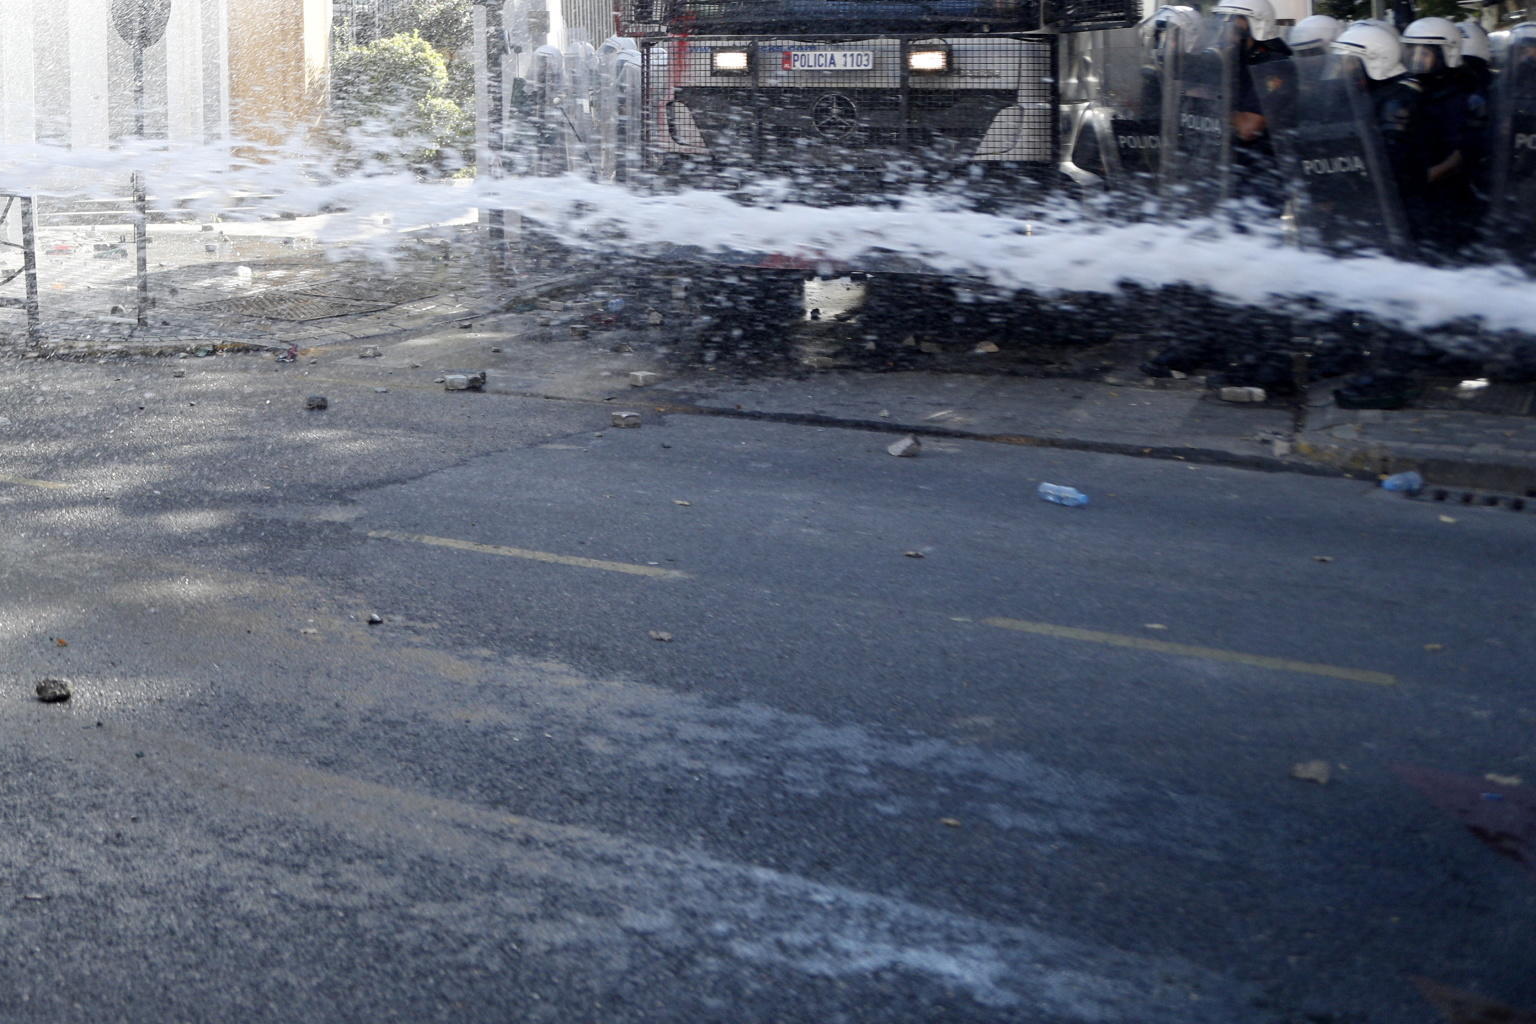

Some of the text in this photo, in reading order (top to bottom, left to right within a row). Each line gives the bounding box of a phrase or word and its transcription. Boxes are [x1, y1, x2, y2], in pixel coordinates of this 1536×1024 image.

[793, 53, 870, 68] POLICIA 1103
[1301, 156, 1366, 175] POLICIA
